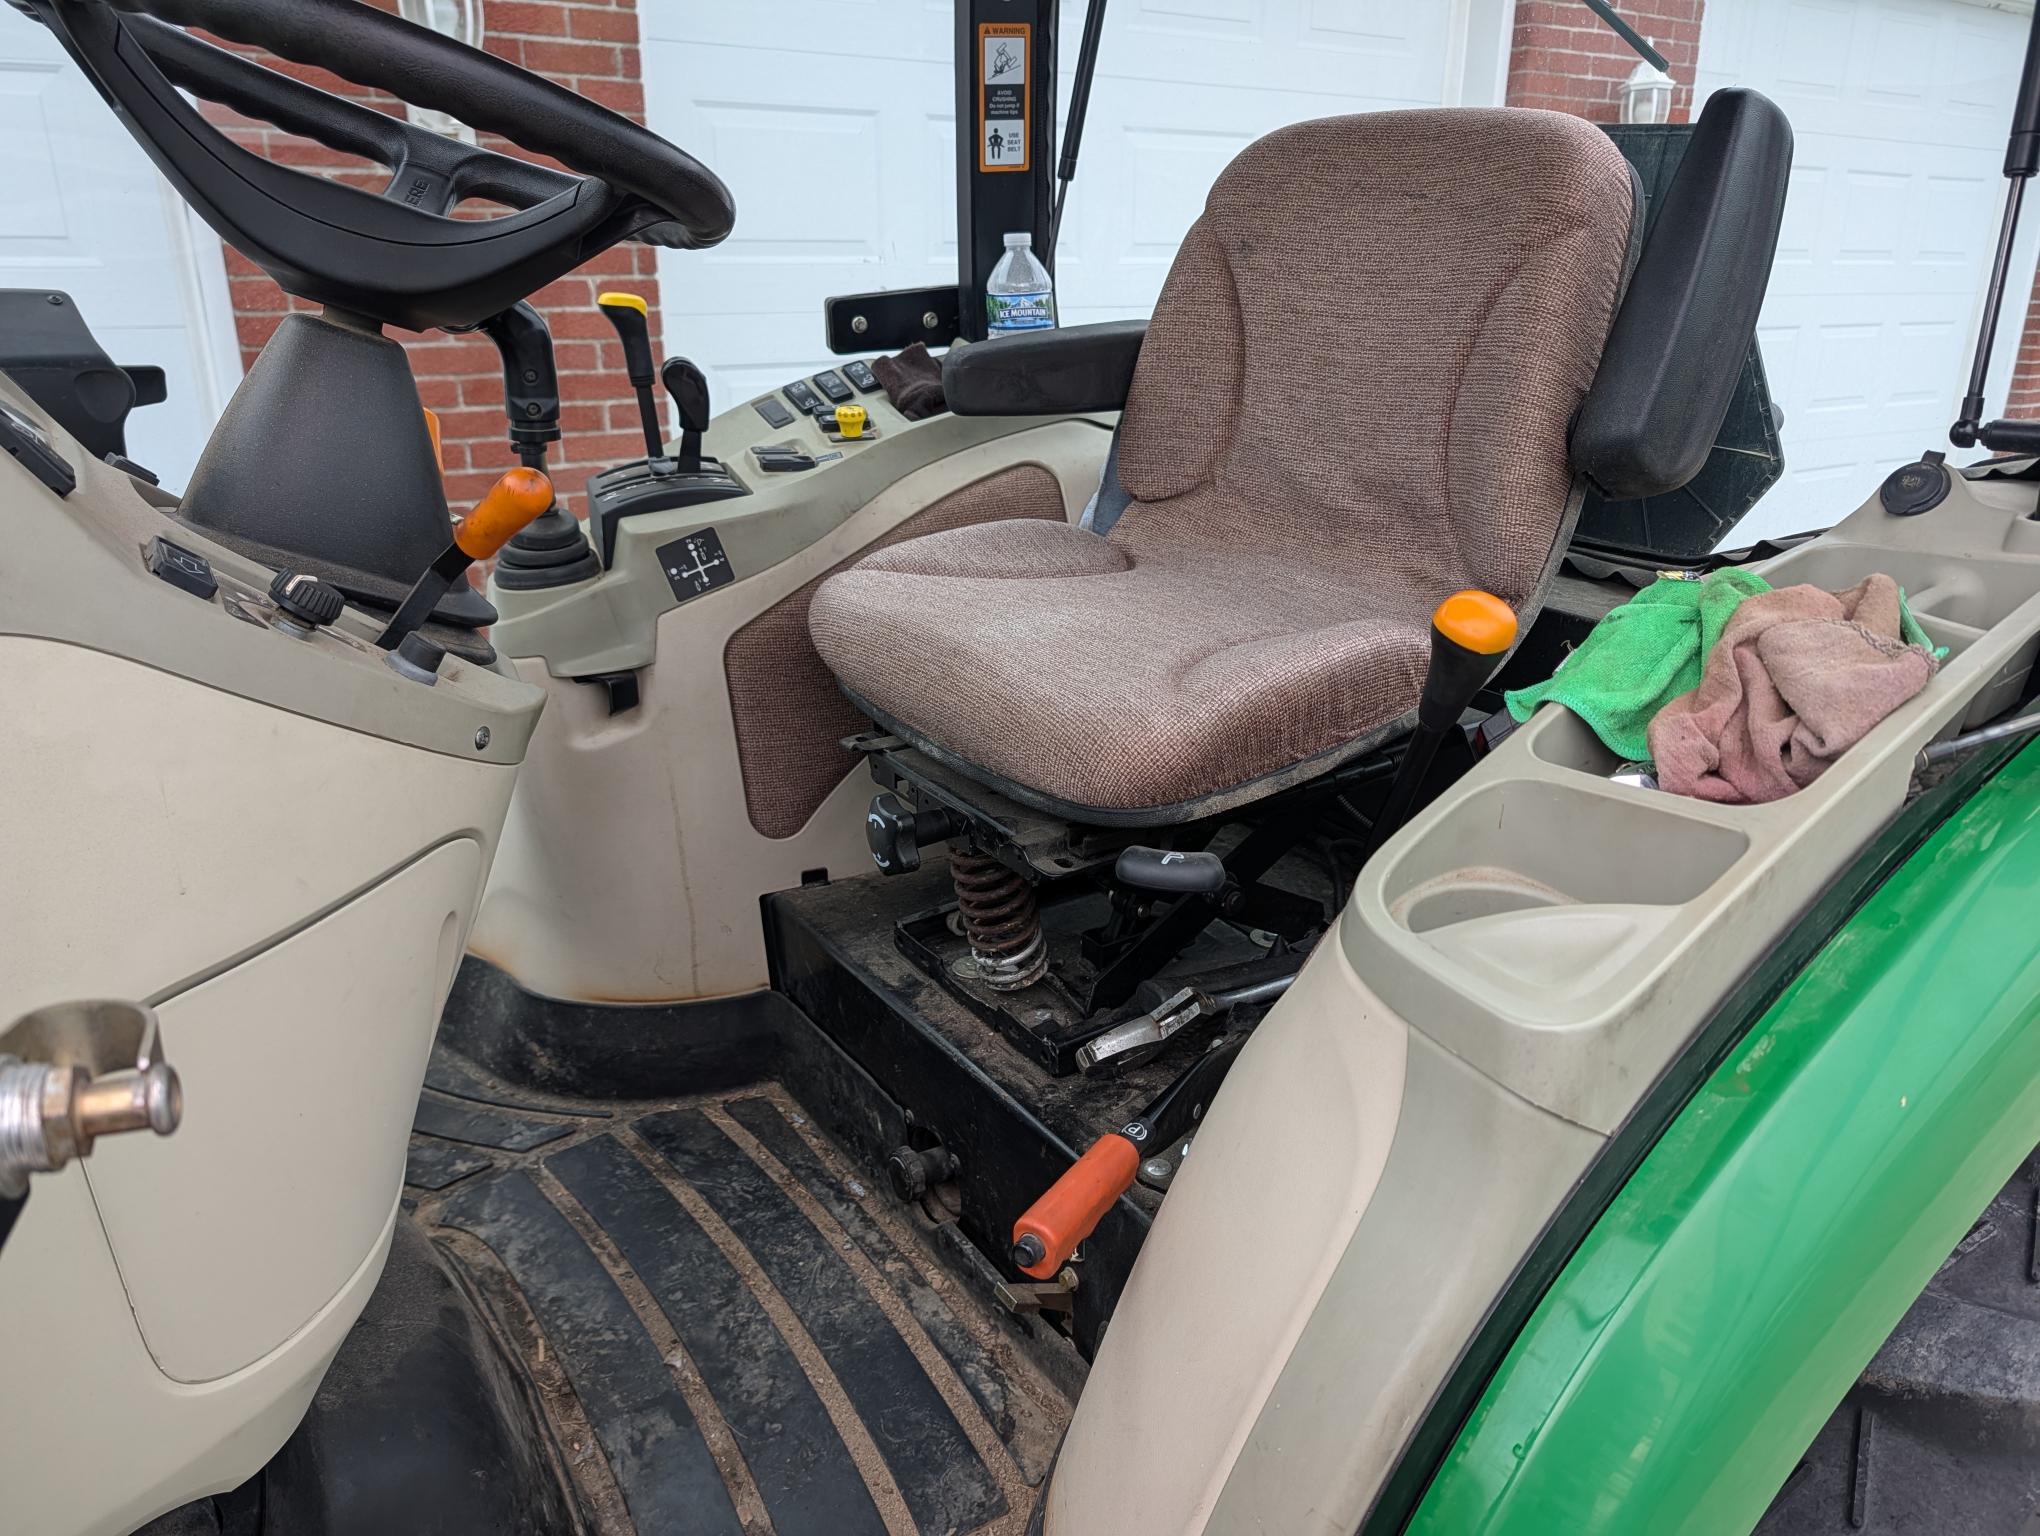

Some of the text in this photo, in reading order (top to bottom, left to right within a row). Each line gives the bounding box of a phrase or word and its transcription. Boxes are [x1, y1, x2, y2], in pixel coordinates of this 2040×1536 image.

[992, 27, 1026, 35] WARNING
[1000, 308, 1045, 318] ICE MOUNTAIN
